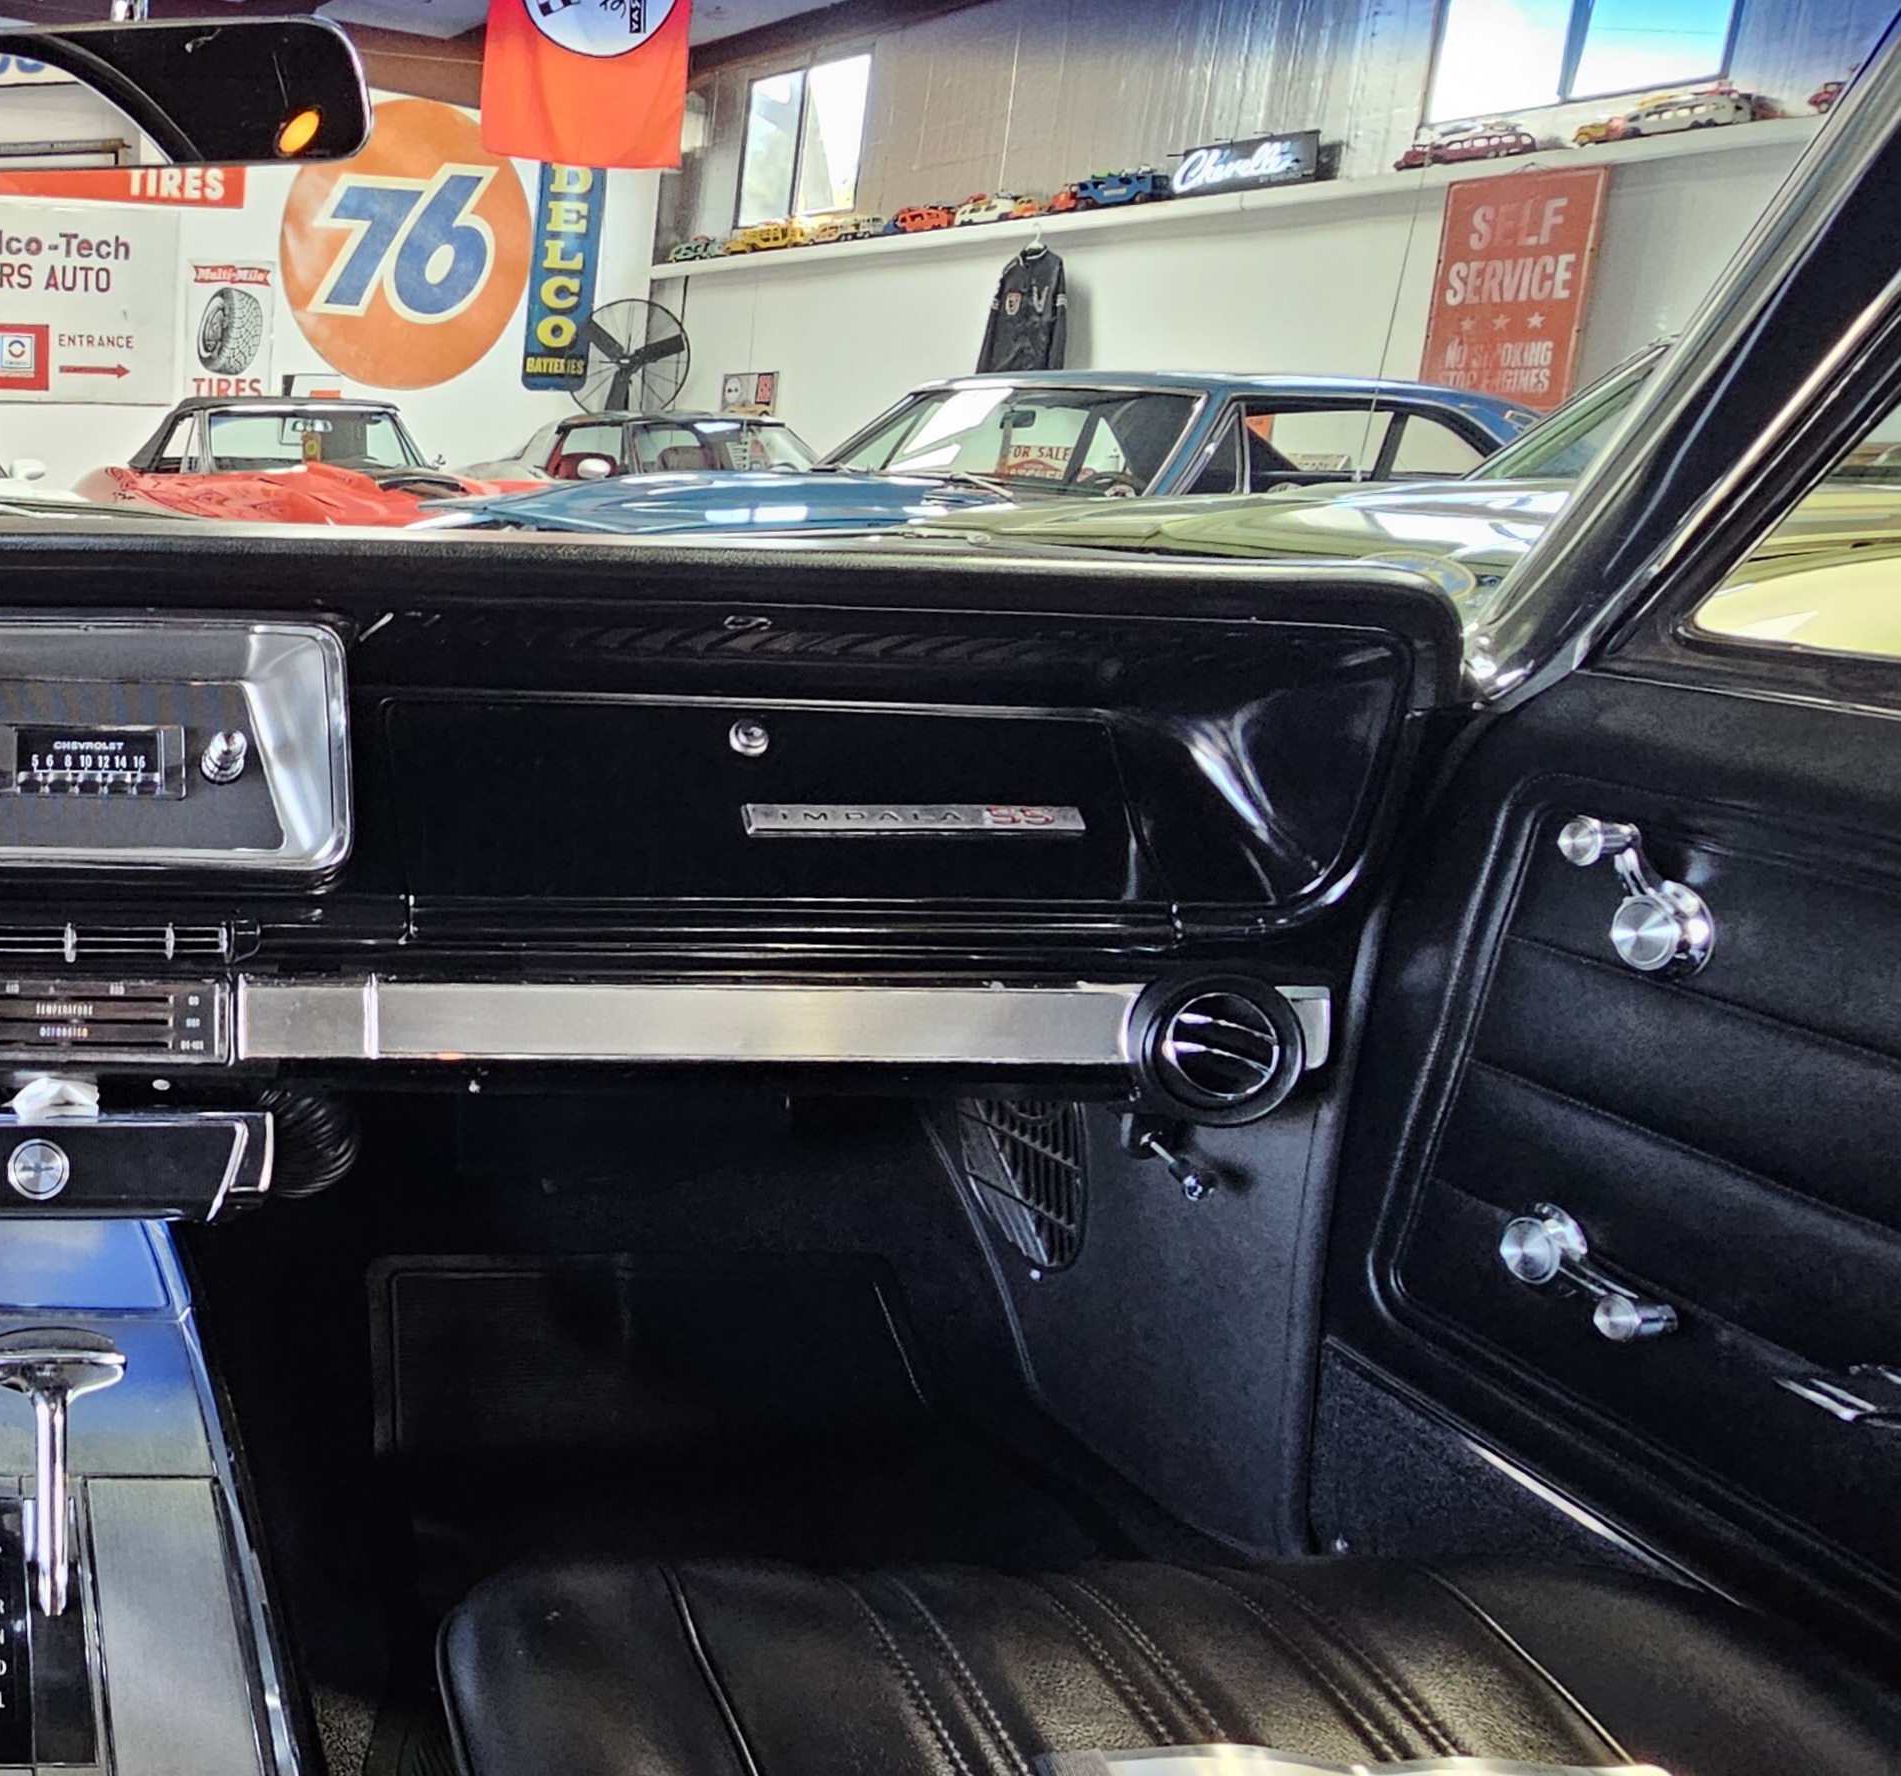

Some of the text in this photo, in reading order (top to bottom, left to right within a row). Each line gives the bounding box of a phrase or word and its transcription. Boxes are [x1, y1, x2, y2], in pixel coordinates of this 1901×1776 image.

[129, 168, 225, 200] TIRES
[1469, 197, 1569, 251] SELF
[309, 164, 498, 322] 76
[536, 164, 593, 348] DELCO
[44, 264, 112, 294] AUTO
[1445, 253, 1576, 306] SERVICE
[58, 333, 135, 350] ENTRANCE
[1444, 335, 1469, 370] NO
[192, 378, 263, 397] TIRES
[1037, 446, 1071, 463] SALE
[53, 741, 124, 751] CHEVROLET
[31, 754, 146, 769] 5 6 8 10 12 14 16
[779, 805, 1055, 825] IMPALA SS
